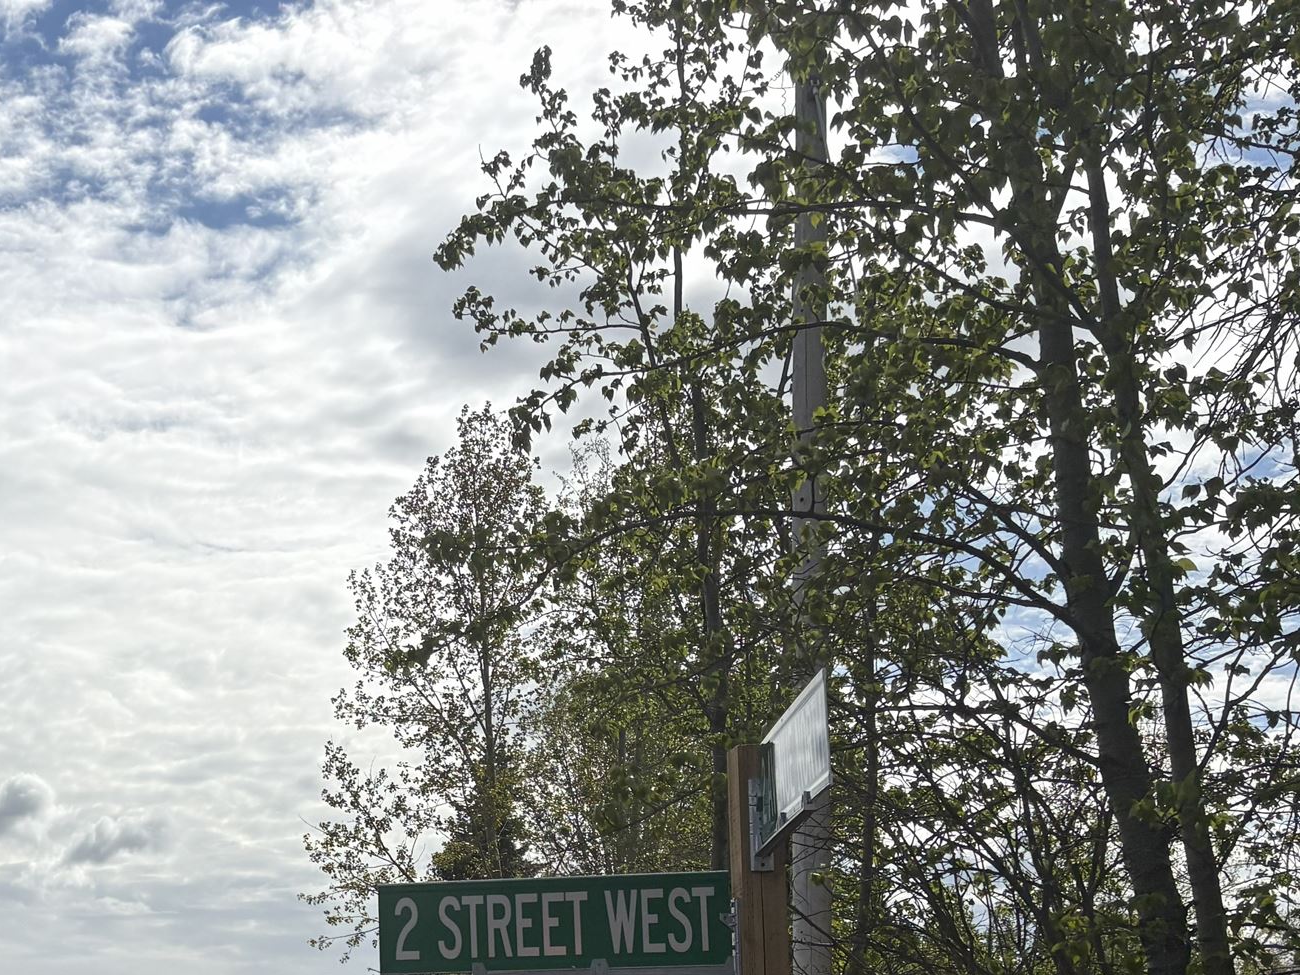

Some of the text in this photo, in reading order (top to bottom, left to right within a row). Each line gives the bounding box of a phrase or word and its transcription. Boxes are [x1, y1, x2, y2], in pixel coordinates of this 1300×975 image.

[394, 886, 715, 961] 2 STREET WEST
